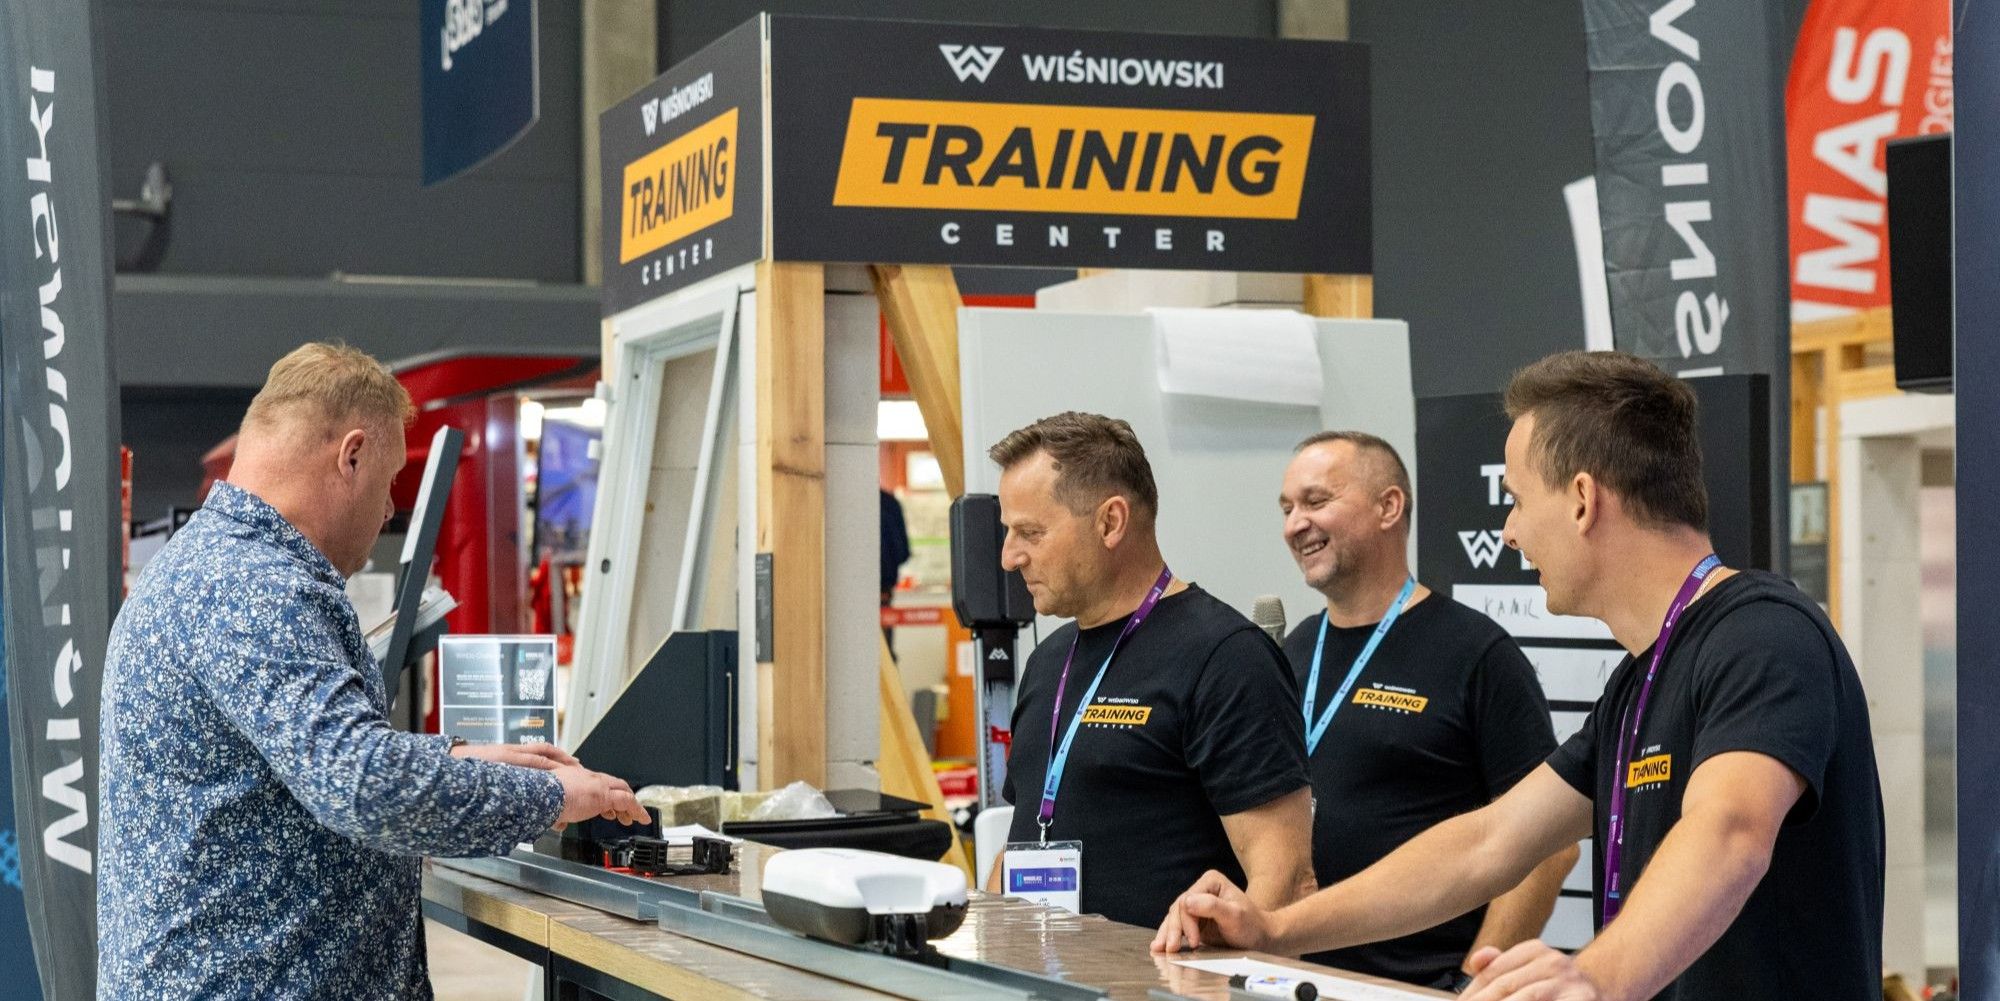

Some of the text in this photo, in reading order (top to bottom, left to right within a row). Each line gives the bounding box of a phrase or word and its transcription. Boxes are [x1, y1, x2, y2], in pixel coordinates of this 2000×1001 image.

[1022, 50, 1224, 89] WIŚNIOWSKI
[876, 122, 1284, 197] TRAINING
[1791, 27, 1912, 323] MAS
[631, 136, 729, 239] TRAINING
[941, 222, 1226, 252] CENTER
[642, 238, 713, 285] CENTER
[1084, 708, 1145, 721] TRAINING
[1360, 691, 1421, 709] TRAINING
